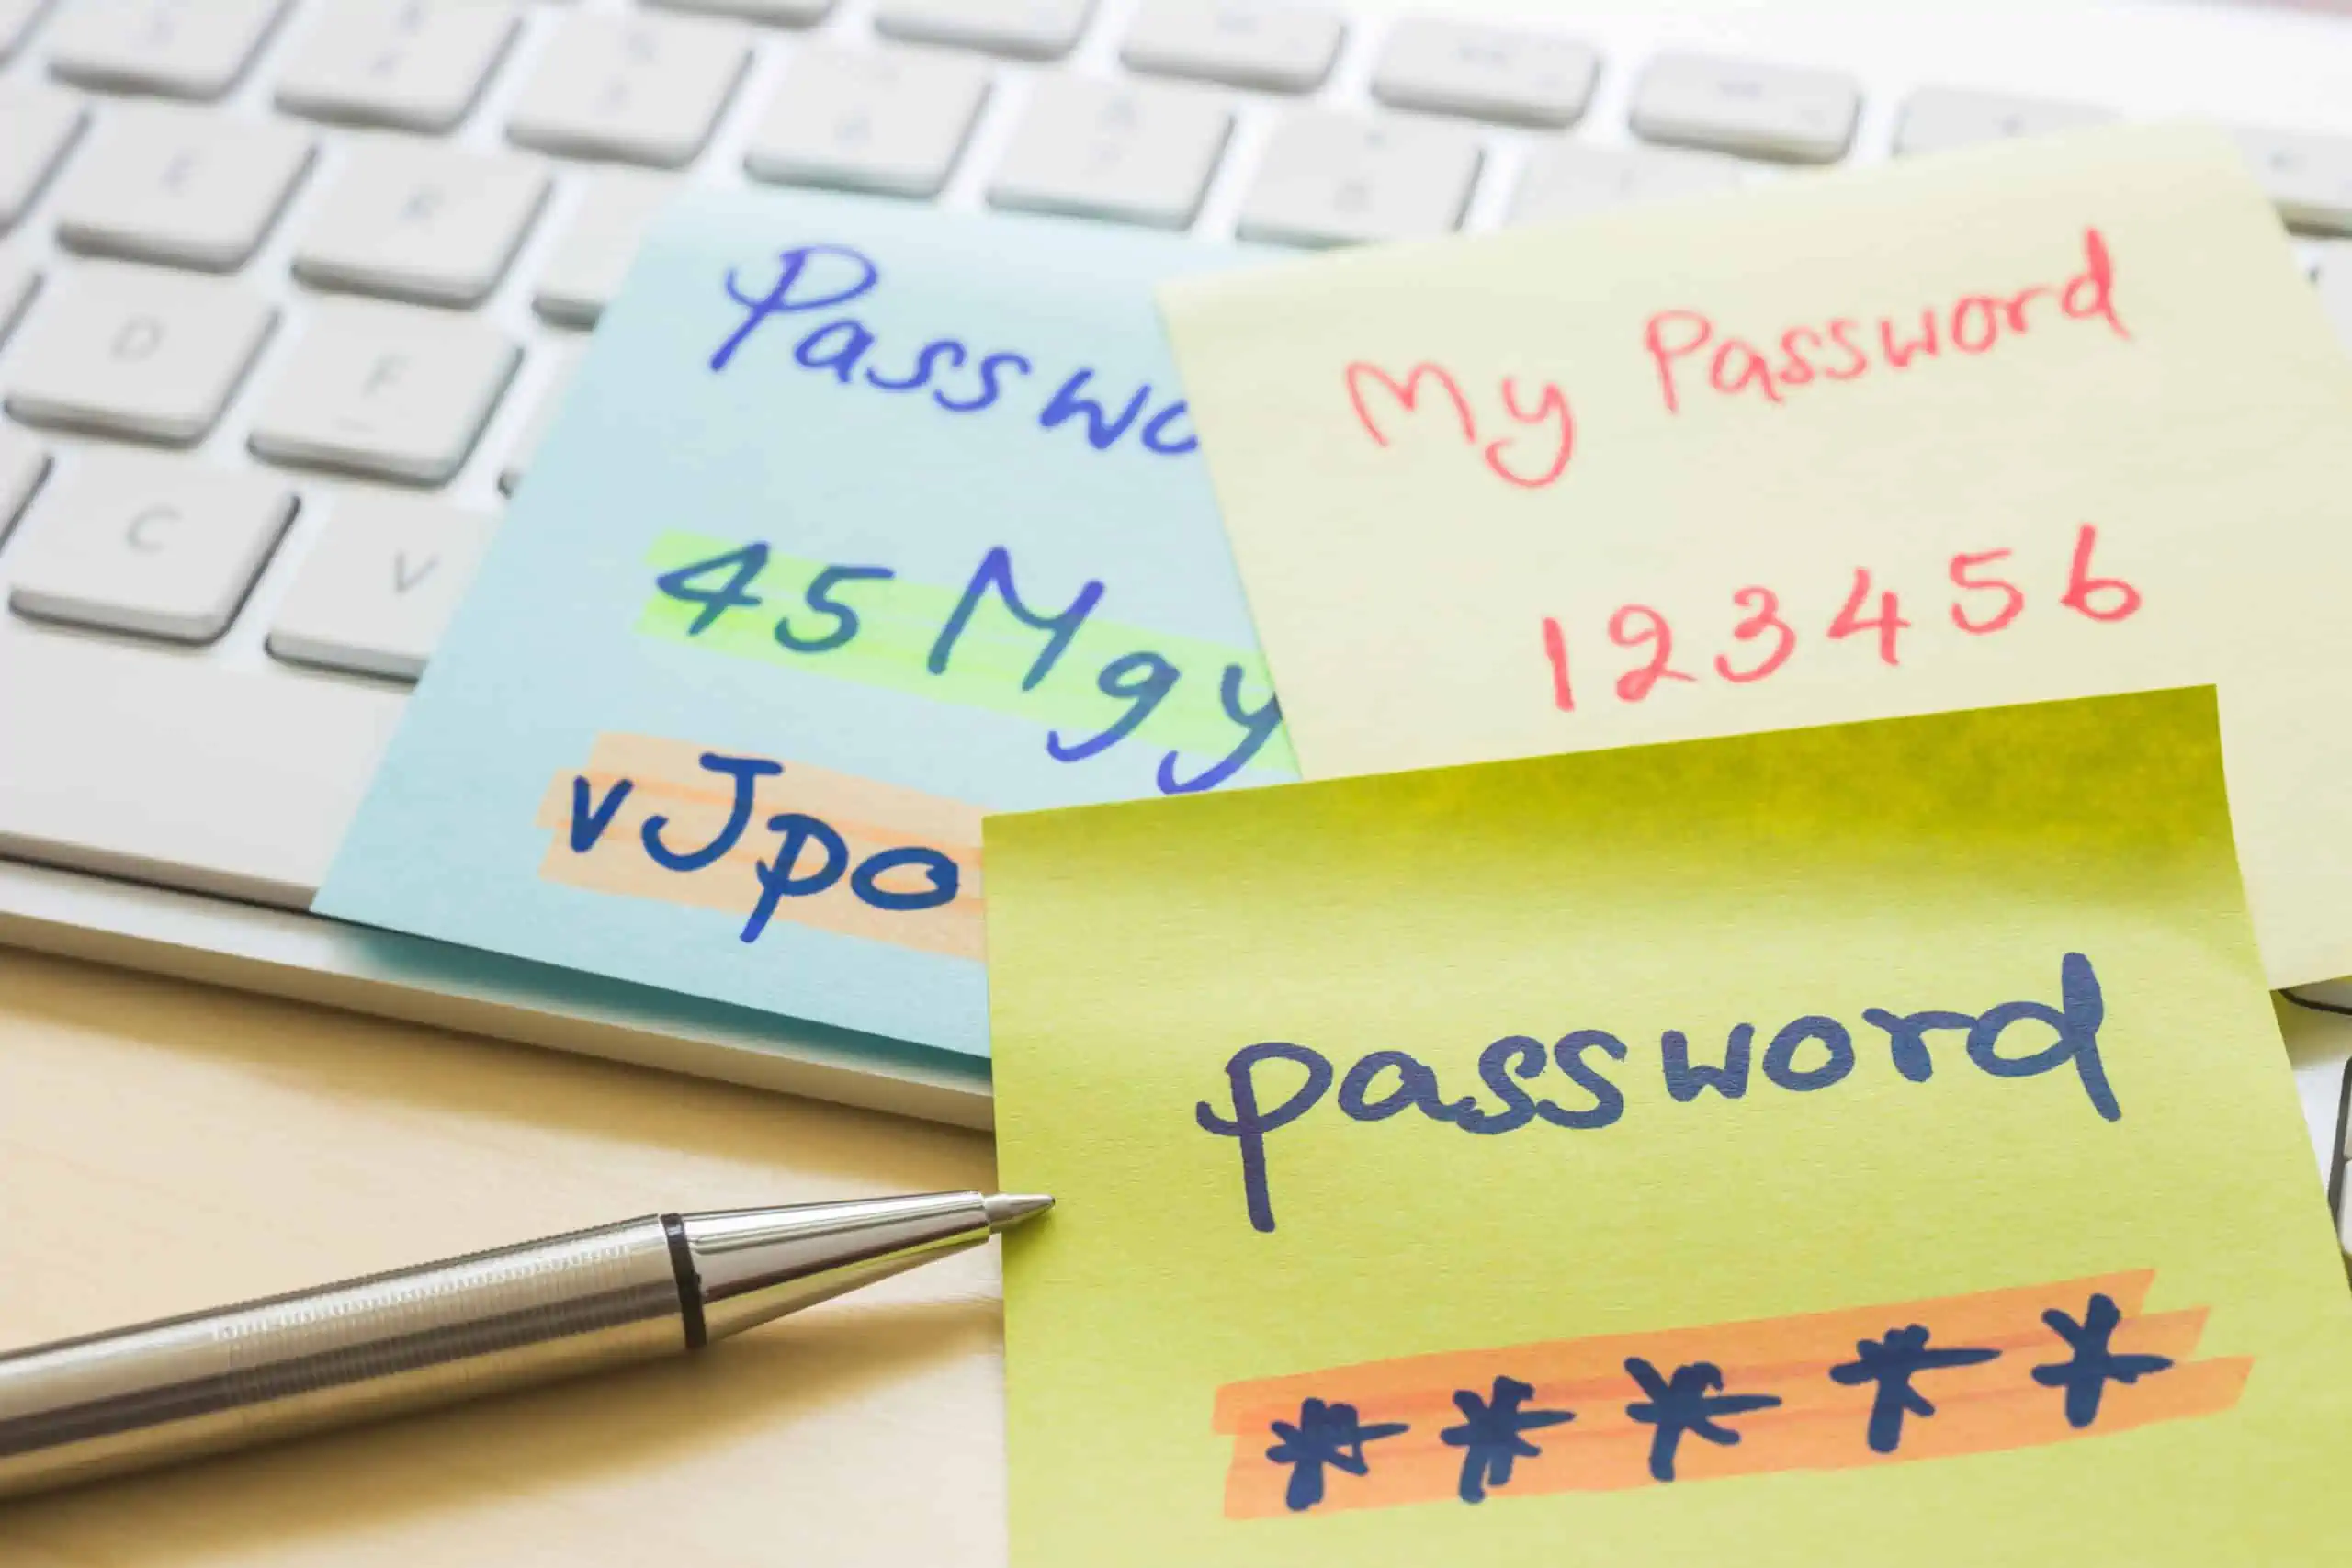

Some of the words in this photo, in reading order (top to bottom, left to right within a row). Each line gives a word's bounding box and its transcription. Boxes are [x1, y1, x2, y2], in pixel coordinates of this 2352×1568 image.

[106, 312, 168, 364] D
[1344, 359, 1577, 489] My
[1642, 226, 2131, 413] Password
[121, 502, 184, 556] C
[390, 550, 443, 597] V
[1195, 951, 2122, 1234] password
